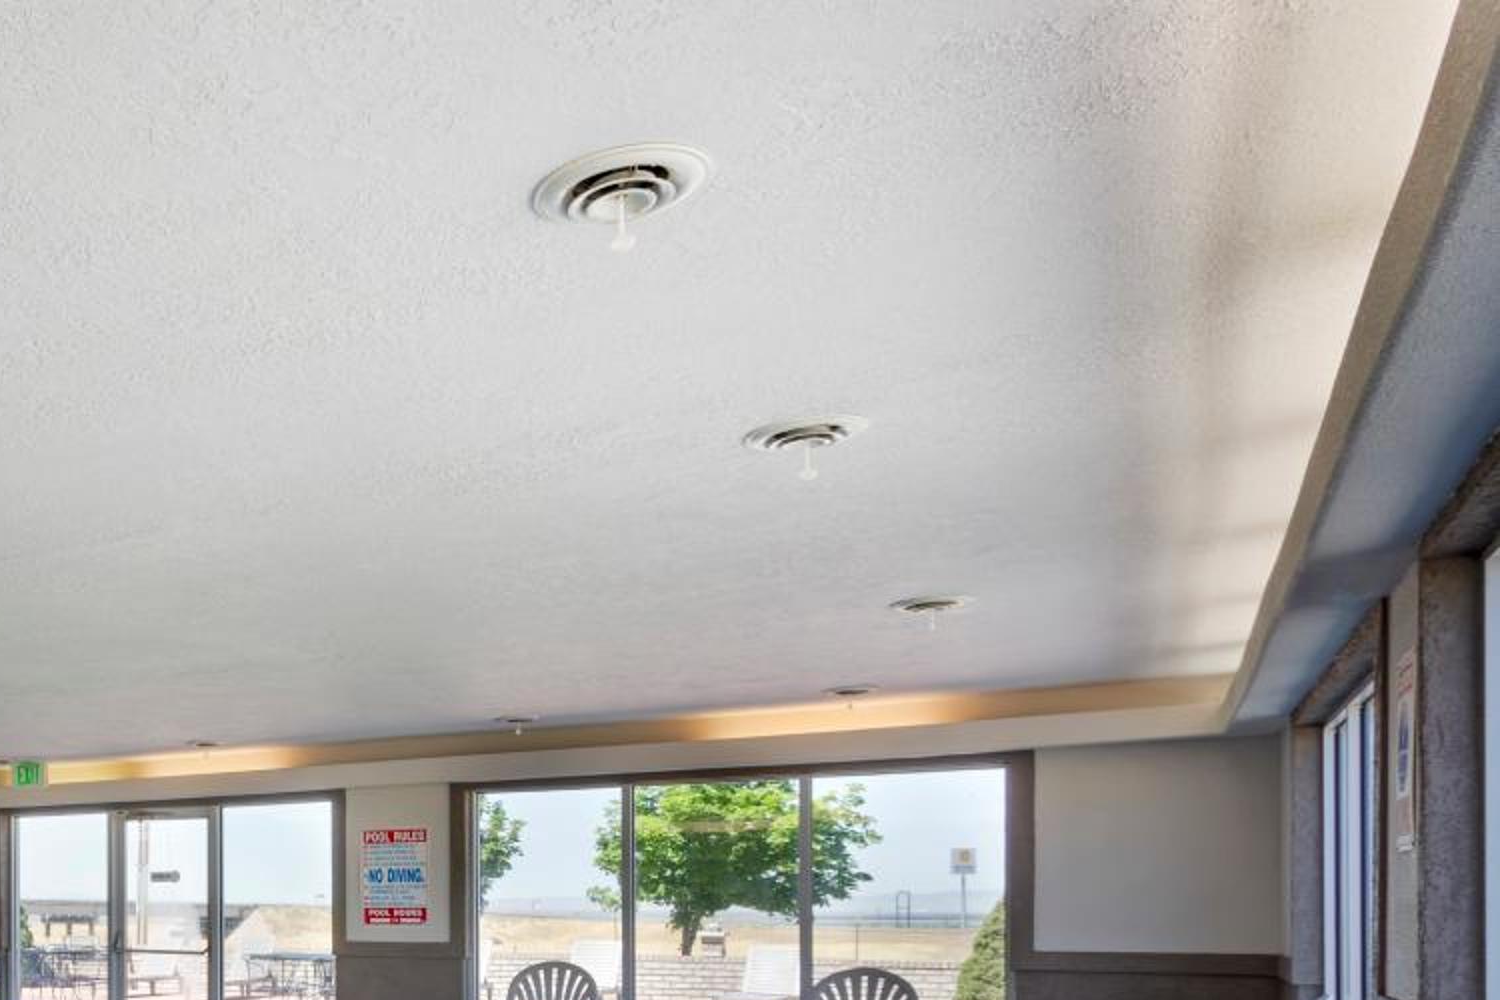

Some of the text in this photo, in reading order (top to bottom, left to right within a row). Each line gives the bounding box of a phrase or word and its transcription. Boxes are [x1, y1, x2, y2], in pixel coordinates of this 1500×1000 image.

[17, 766, 40, 785] EXIT
[365, 830, 424, 843] POOL RULES
[368, 868, 383, 883] NO
